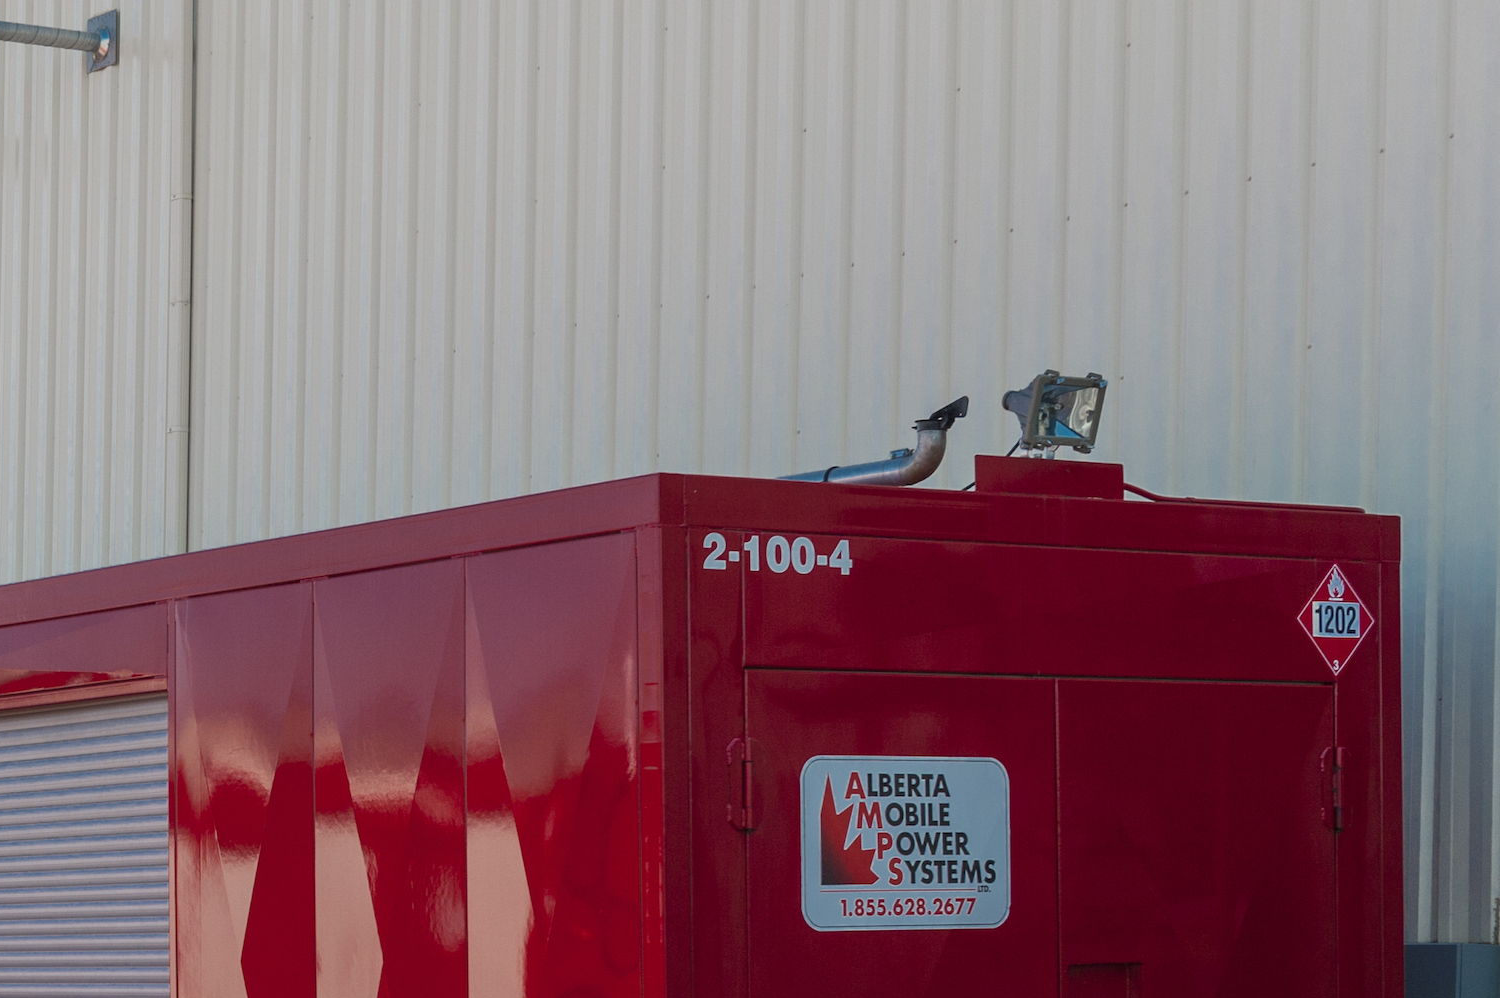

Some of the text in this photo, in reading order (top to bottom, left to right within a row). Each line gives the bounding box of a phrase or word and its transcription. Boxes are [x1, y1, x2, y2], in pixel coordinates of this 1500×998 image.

[703, 532, 853, 575] 2-100-4
[1315, 604, 1357, 635] 1202
[1333, 659, 1340, 671] 3
[844, 772, 951, 799] ALBERTA
[856, 801, 950, 829] MOBILE
[877, 831, 970, 860] POWER
[888, 857, 996, 886] SYSTEMS
[977, 885, 992, 893] LTD.
[840, 898, 977, 917] 1.855.628.2677
